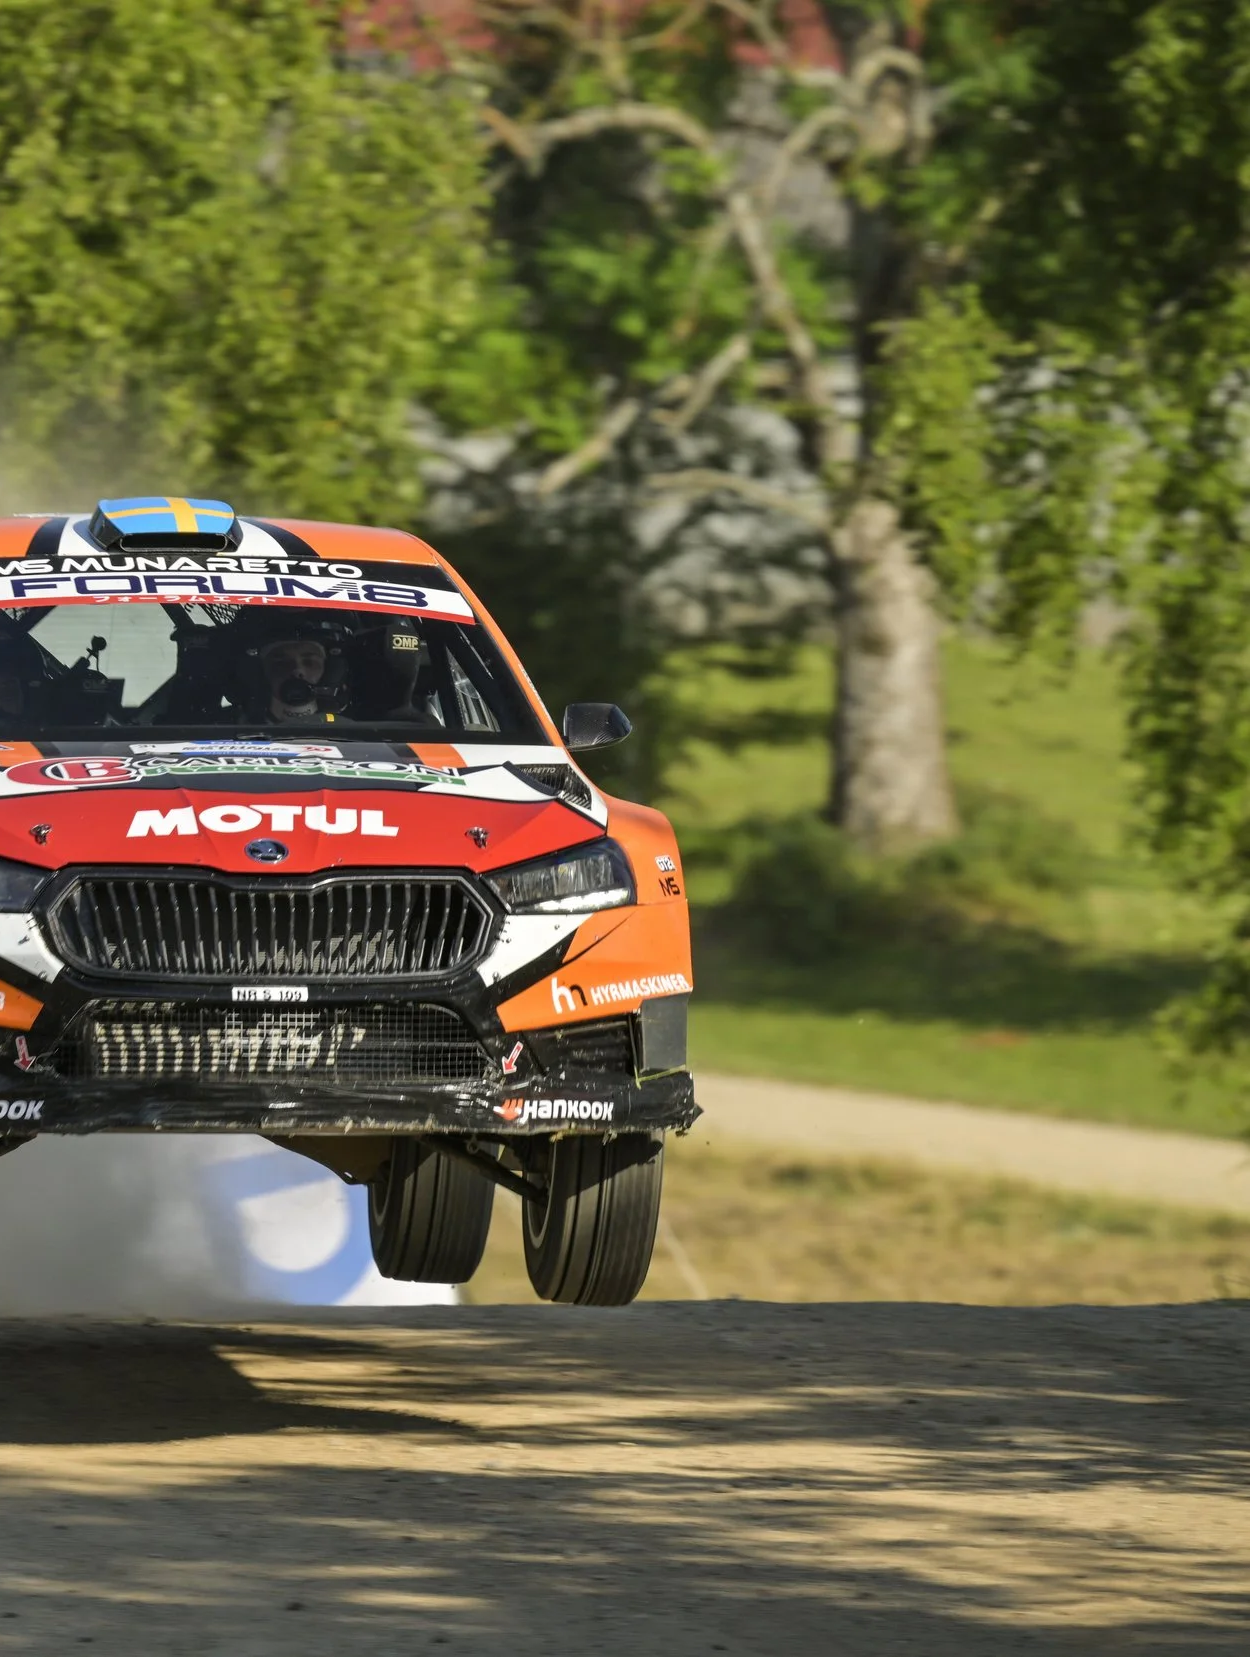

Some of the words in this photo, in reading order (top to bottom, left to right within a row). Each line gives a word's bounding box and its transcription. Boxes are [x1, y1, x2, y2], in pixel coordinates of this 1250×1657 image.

[61, 556, 363, 579] MUNARETTO
[11, 574, 429, 608] FORUM8
[392, 638, 419, 648] OMP
[126, 804, 400, 838] MOTUL
[590, 973, 691, 1006] HYRMASKINER
